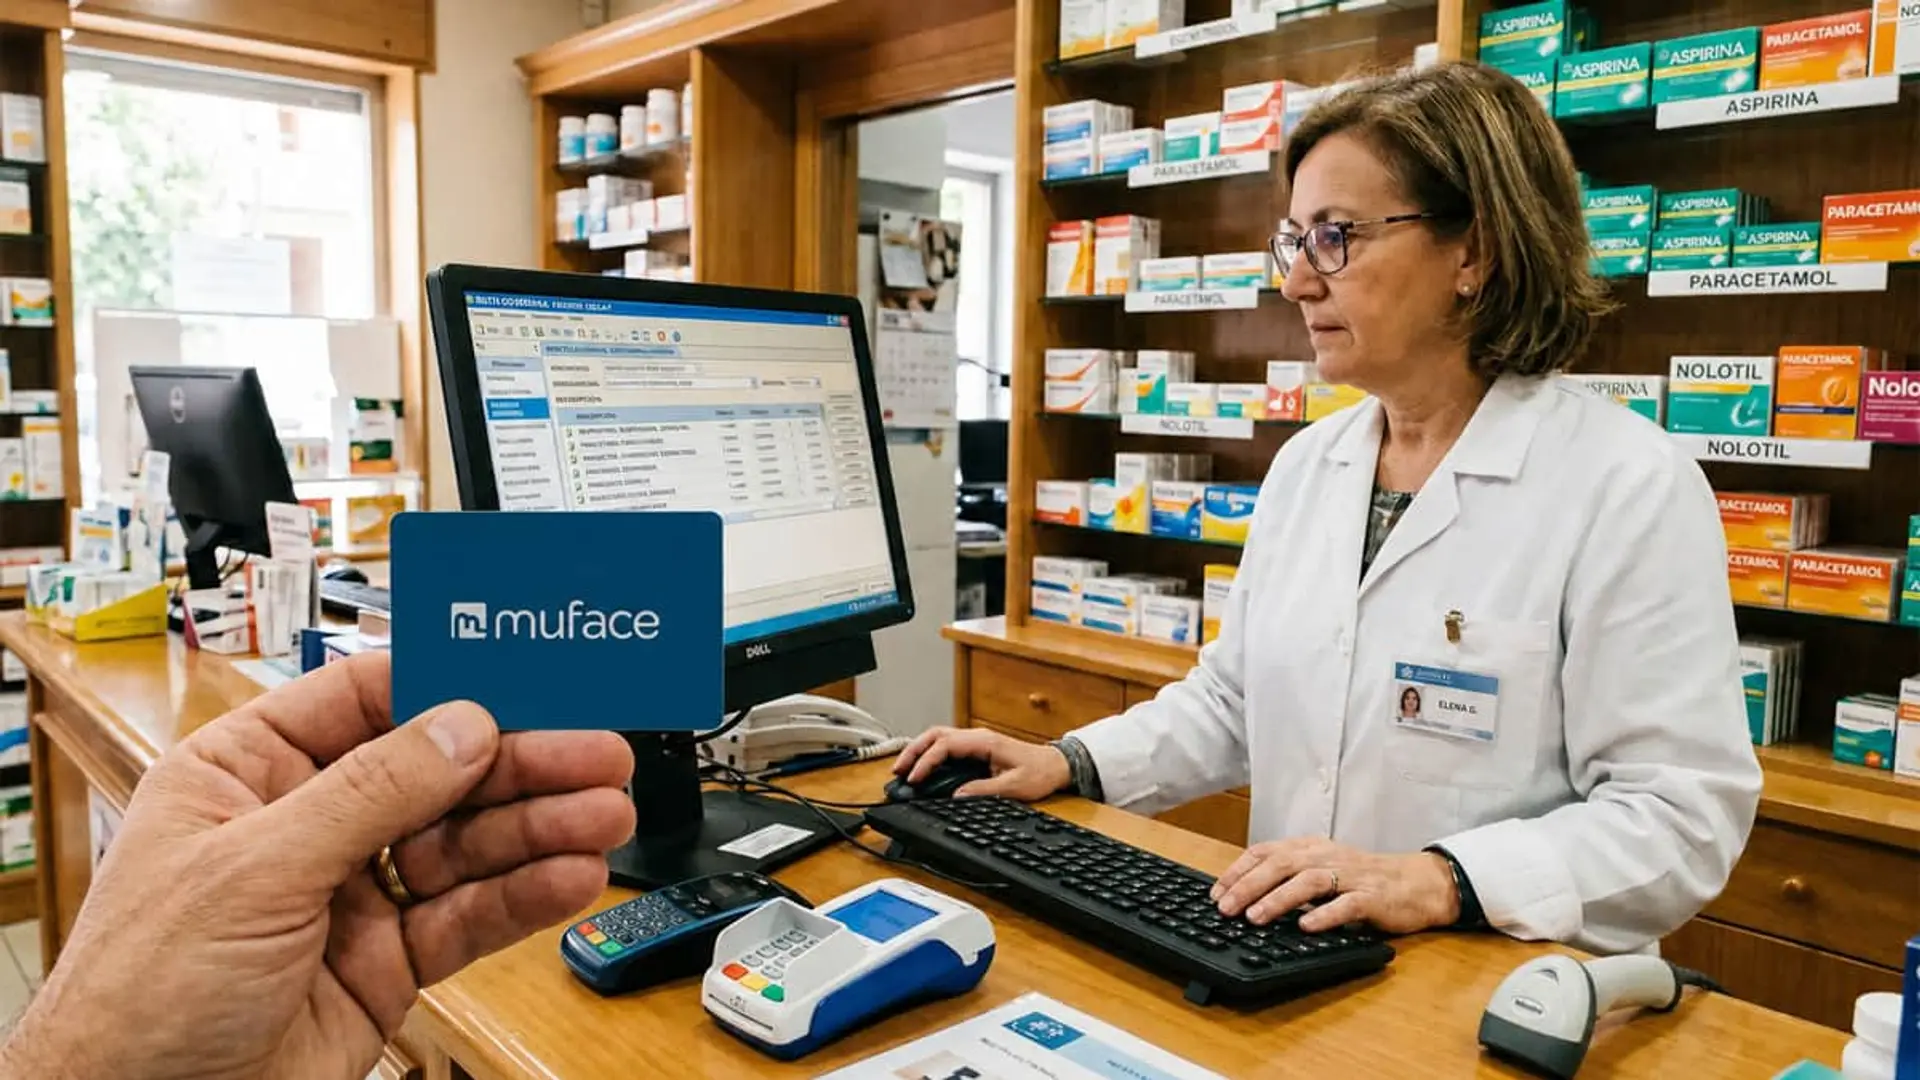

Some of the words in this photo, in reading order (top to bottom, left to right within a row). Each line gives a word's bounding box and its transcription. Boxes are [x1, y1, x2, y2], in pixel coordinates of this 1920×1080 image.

[1493, 12, 1555, 33] ASPIRINA
[1766, 22, 1863, 47] PARACETAMOL
[1669, 41, 1745, 65] ASPIRINA
[1572, 57, 1640, 78] ASPIRINA
[1726, 90, 1819, 115] ASPIRINA
[1588, 194, 1643, 208] ASPIRINA
[1672, 197, 1729, 210] ASPIRINA
[1827, 200, 1920, 219] PARACETAM
[1663, 235, 1722, 249] ASPIRINA
[1747, 230, 1810, 244] ASPIRINA
[1689, 270, 1837, 288] PARACETAMOL
[1782, 353, 1855, 365] PARACETAMOL
[1676, 363, 1762, 379] NOLOTIL
[1159, 418, 1209, 433] NOLOTIL
[1707, 440, 1790, 459] NOLOTIL
[1792, 558, 1883, 578] PARACETAMOL
[495, 600, 660, 640] muface
[746, 643, 771, 659] DELL
[1438, 699, 1467, 712] ELENA
